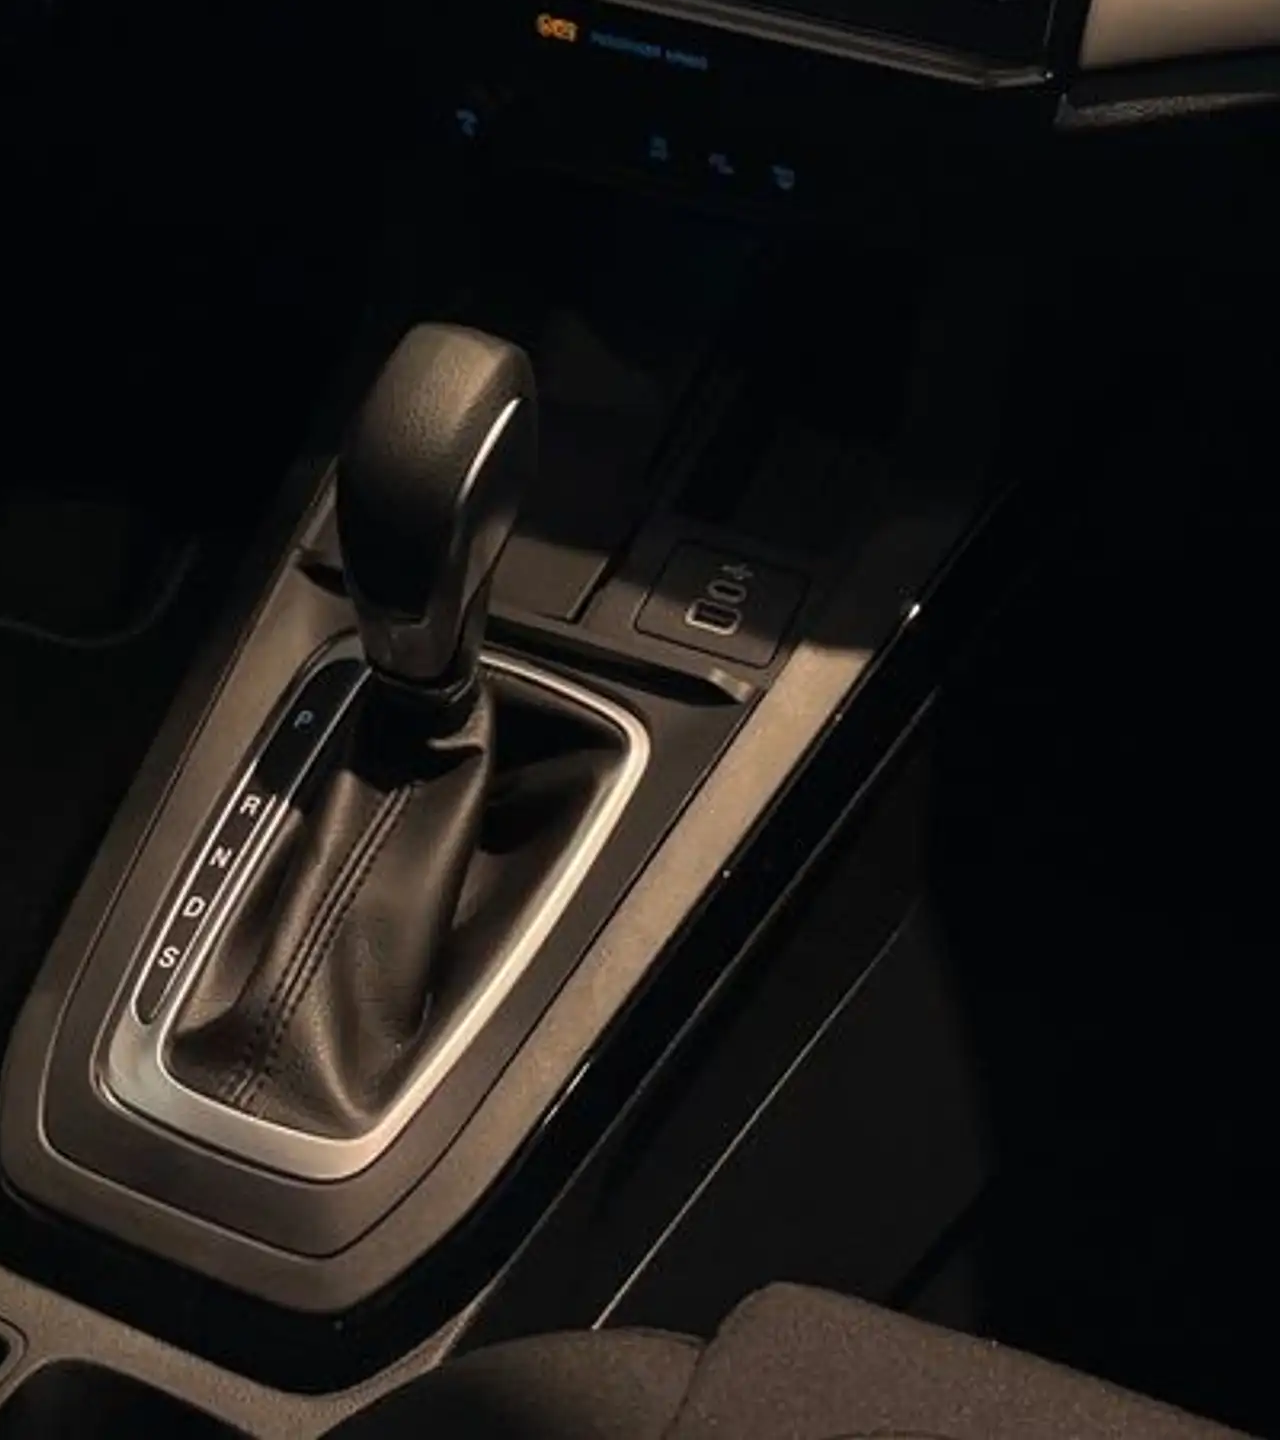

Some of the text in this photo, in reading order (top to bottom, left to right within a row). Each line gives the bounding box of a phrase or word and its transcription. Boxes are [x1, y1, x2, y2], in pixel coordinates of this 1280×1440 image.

[294, 710, 313, 731] P
[239, 794, 261, 817] R
[209, 846, 232, 869] N
[182, 896, 206, 919] D
[157, 945, 180, 970] S
